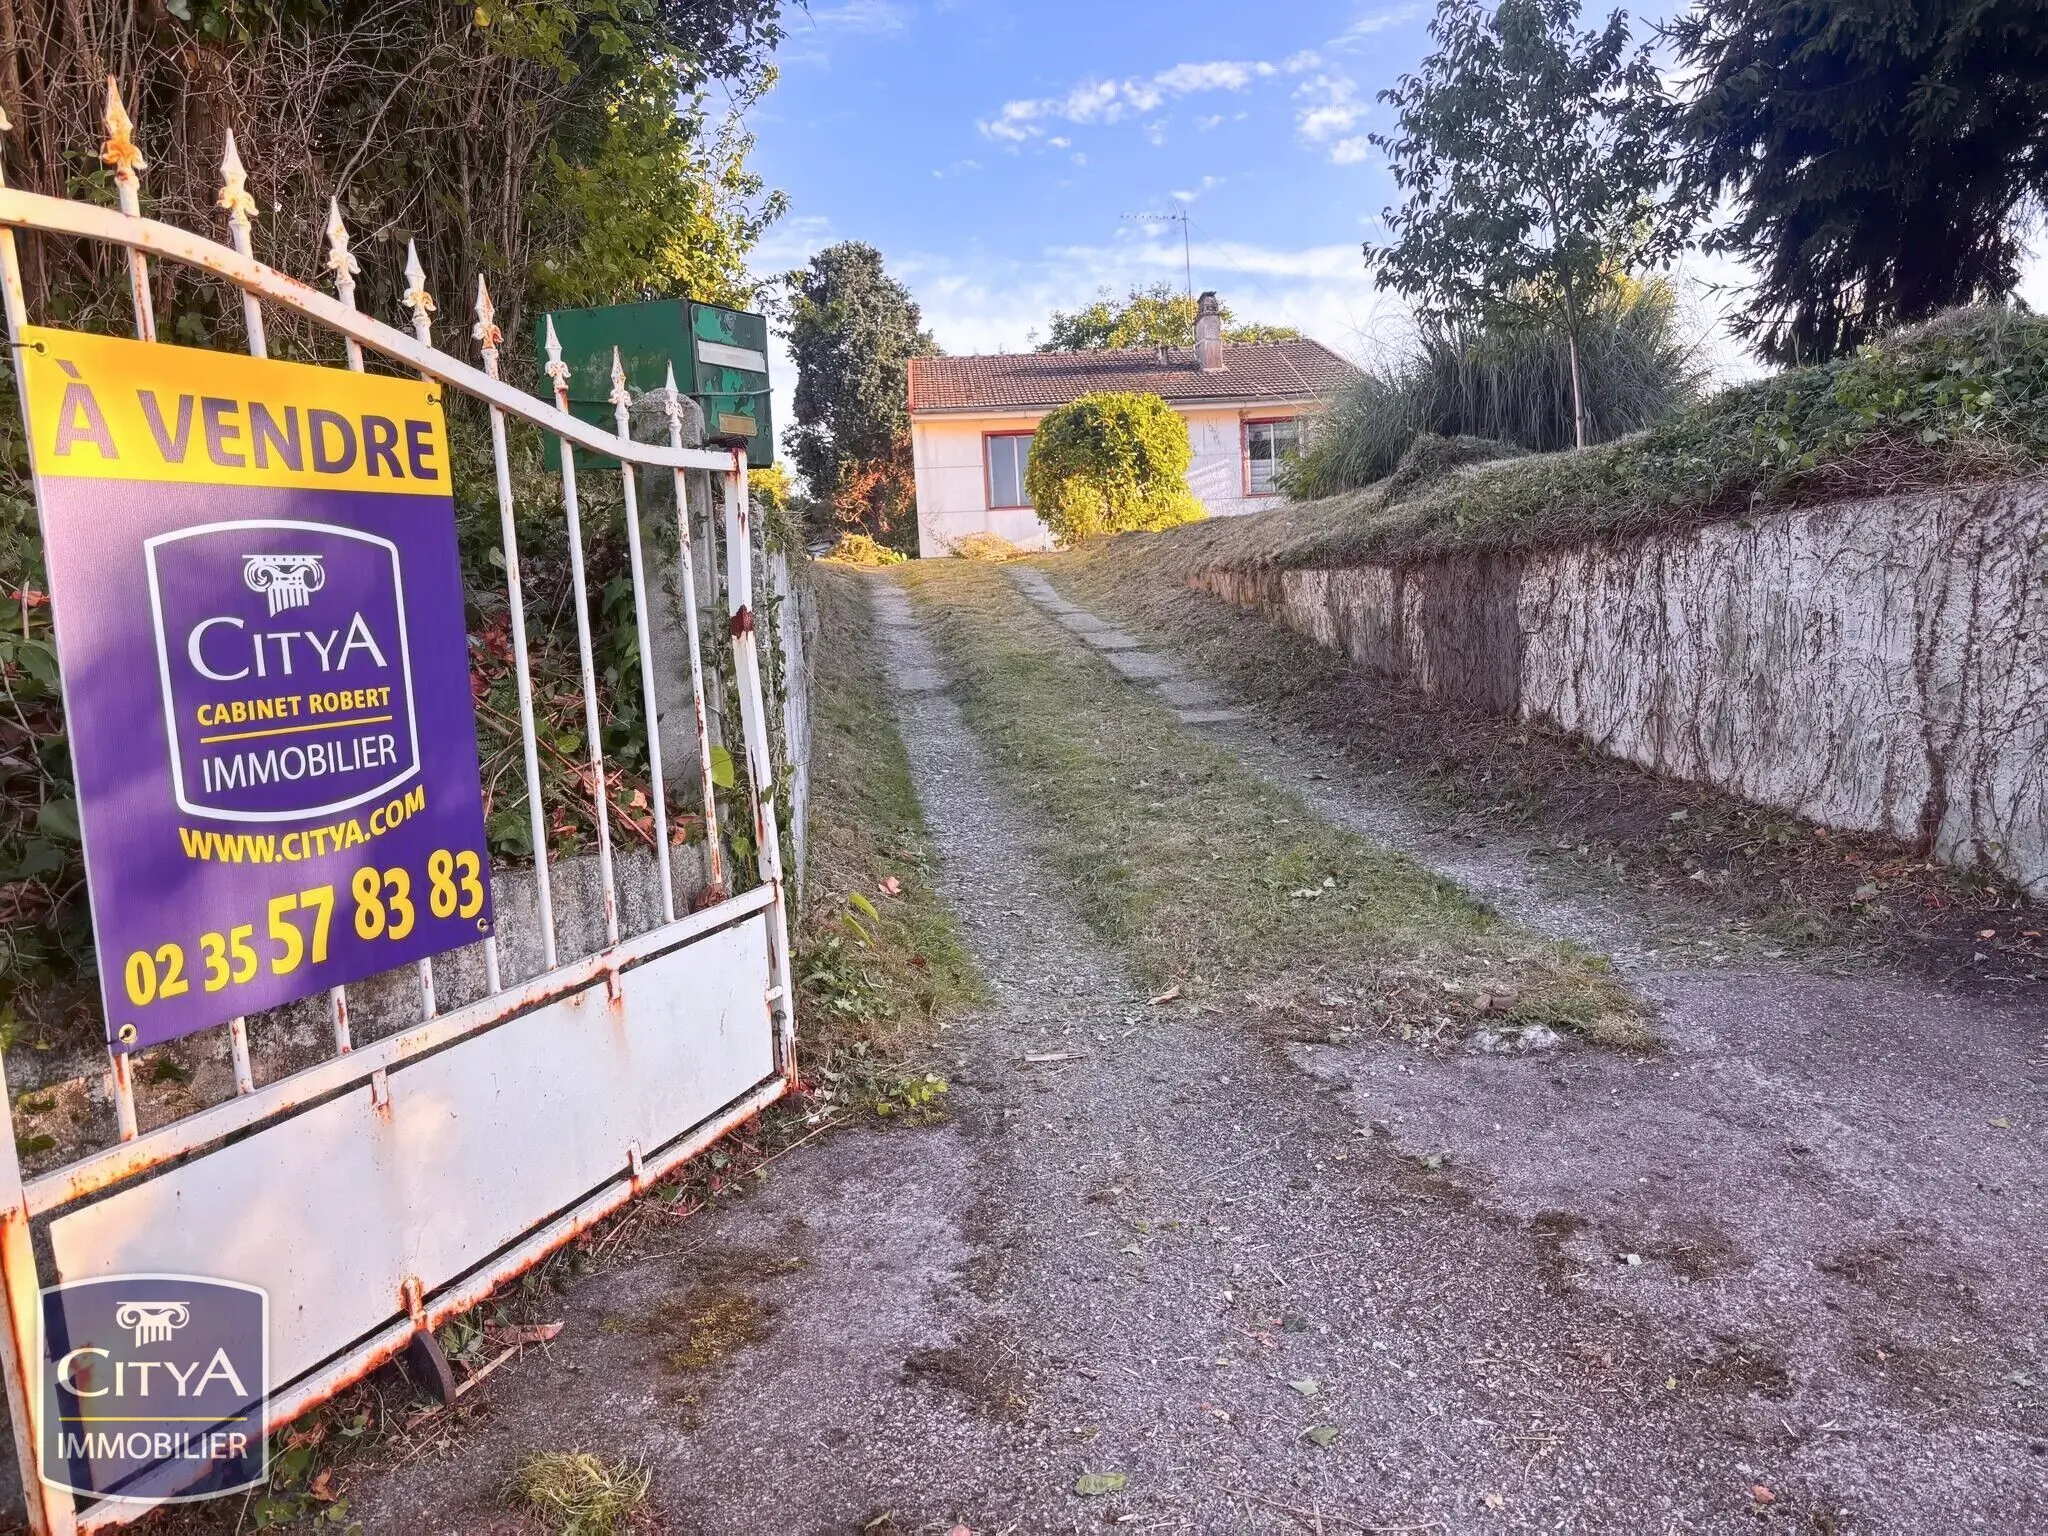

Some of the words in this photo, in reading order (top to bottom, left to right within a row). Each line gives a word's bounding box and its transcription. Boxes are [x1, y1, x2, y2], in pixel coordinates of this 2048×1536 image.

[54, 360, 120, 459] À
[136, 389, 439, 480] VENDRE
[187, 611, 388, 681] CITYA
[197, 695, 301, 727] CABINET
[309, 686, 391, 714] ROBERT
[202, 734, 397, 793] IMMOBILIER
[178, 785, 426, 864] WWW.CITYA.COM
[124, 943, 188, 1007] 02
[200, 924, 258, 993] 35
[267, 885, 335, 976] 57
[351, 866, 415, 941] 83
[427, 849, 484, 920] 83
